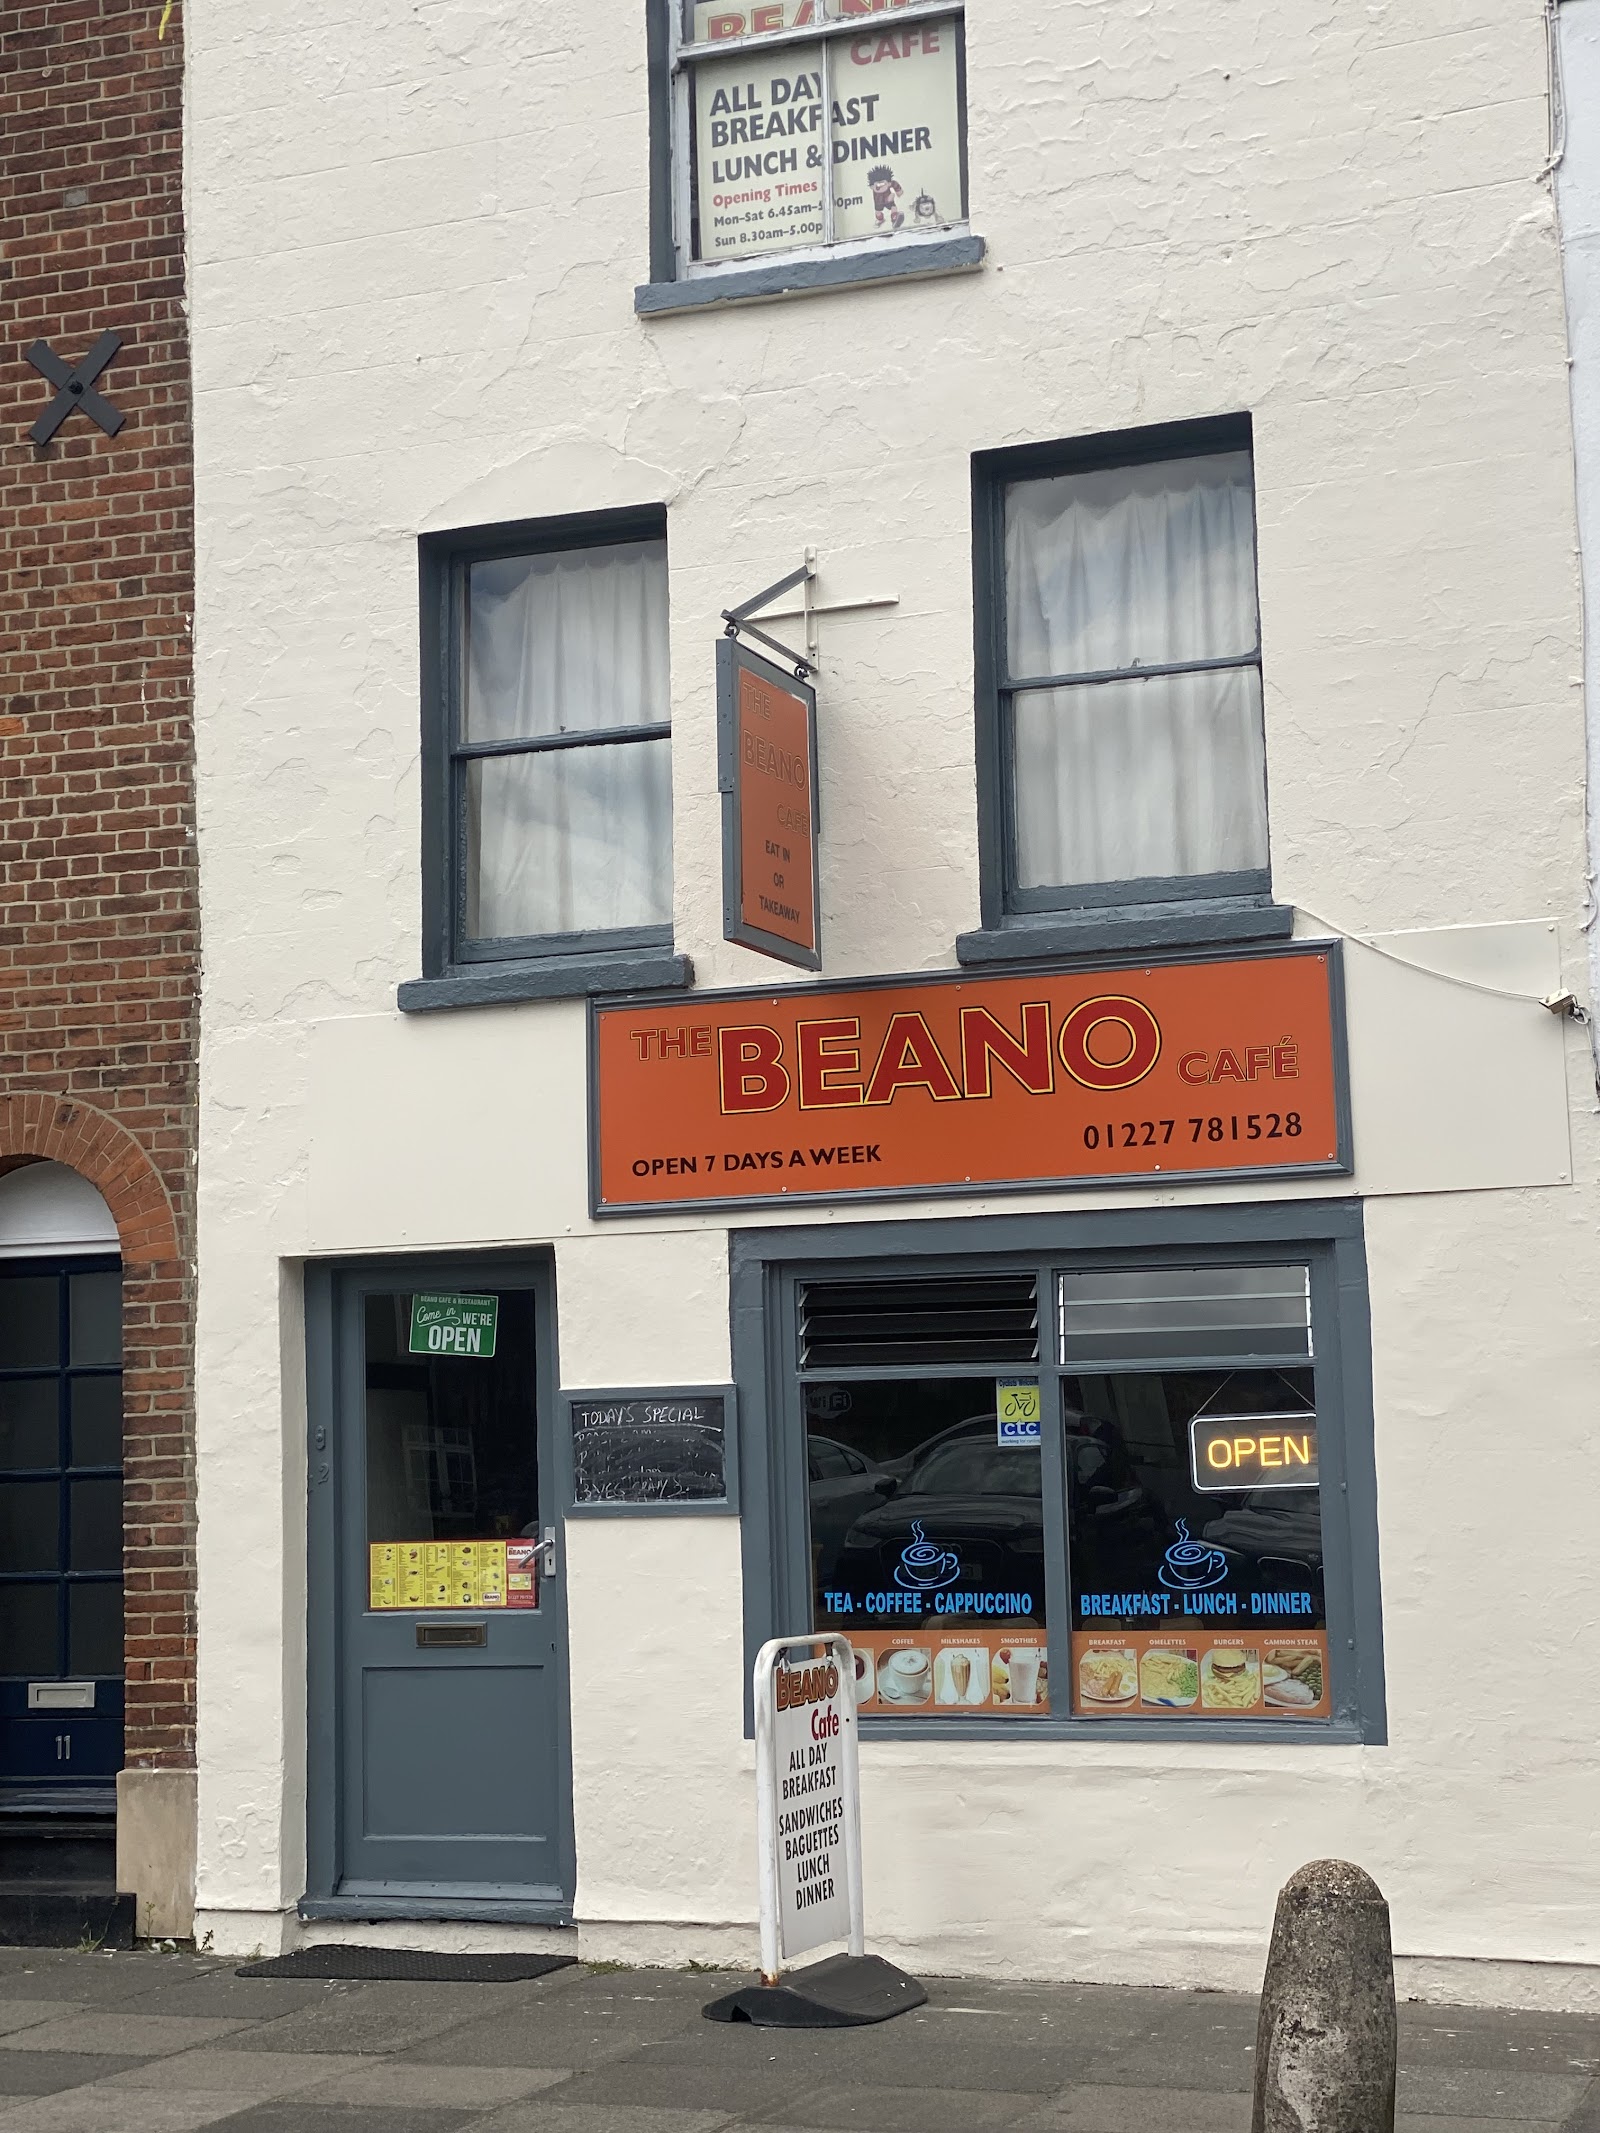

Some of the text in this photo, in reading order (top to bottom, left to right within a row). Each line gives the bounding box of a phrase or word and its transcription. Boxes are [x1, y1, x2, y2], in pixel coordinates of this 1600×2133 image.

[850, 27, 940, 66] CAFE
[710, 72, 822, 116] ALL DAY
[711, 94, 880, 148] BREAKFAST
[712, 126, 932, 183] LUNCH & DINNER
[713, 181, 818, 209] Opening Times
[715, 235, 736, 247] Sun
[743, 682, 771, 720] THE
[743, 730, 806, 791] BEANO
[765, 840, 791, 863] EAT IN
[773, 872, 784, 889] OR
[759, 895, 800, 924] TAKEAWAY
[630, 994, 1299, 1115] THE BEANO CAFÉ
[1084, 1111, 1302, 1150] 01227 781528
[632, 1144, 882, 1177] OPEN 7 DAYS A WEEK
[417, 1306, 493, 1326] Come in WE'RE
[439, 1296, 451, 1304] CAFE
[458, 1298, 490, 1306] RESTAURANT
[428, 1325, 481, 1353] OPEN
[643, 1405, 704, 1424] SPECIAL
[1207, 1435, 1310, 1468] OPEN
[824, 1592, 853, 1613] TEA
[865, 1592, 922, 1613] COFFEE
[934, 1592, 1033, 1614] CAPPUCCINO
[1080, 1593, 1171, 1616] BREAKFAST
[1183, 1593, 1237, 1615] LUNCH
[1251, 1592, 1312, 1614] DINNER
[1000, 1637, 1038, 1645] SMOOTHIES
[776, 1664, 839, 1712] BEANO
[811, 1704, 839, 1741] Cafe
[55, 1735, 71, 1760] 11
[789, 1742, 828, 1772] ALL DAY
[782, 1766, 836, 1800] BREAKFAST
[779, 1797, 843, 1837] SANDWICHES
[785, 1823, 839, 1861] BAGUETTES
[797, 1853, 830, 1883] LUNCH
[796, 1878, 835, 1911] DINNER
